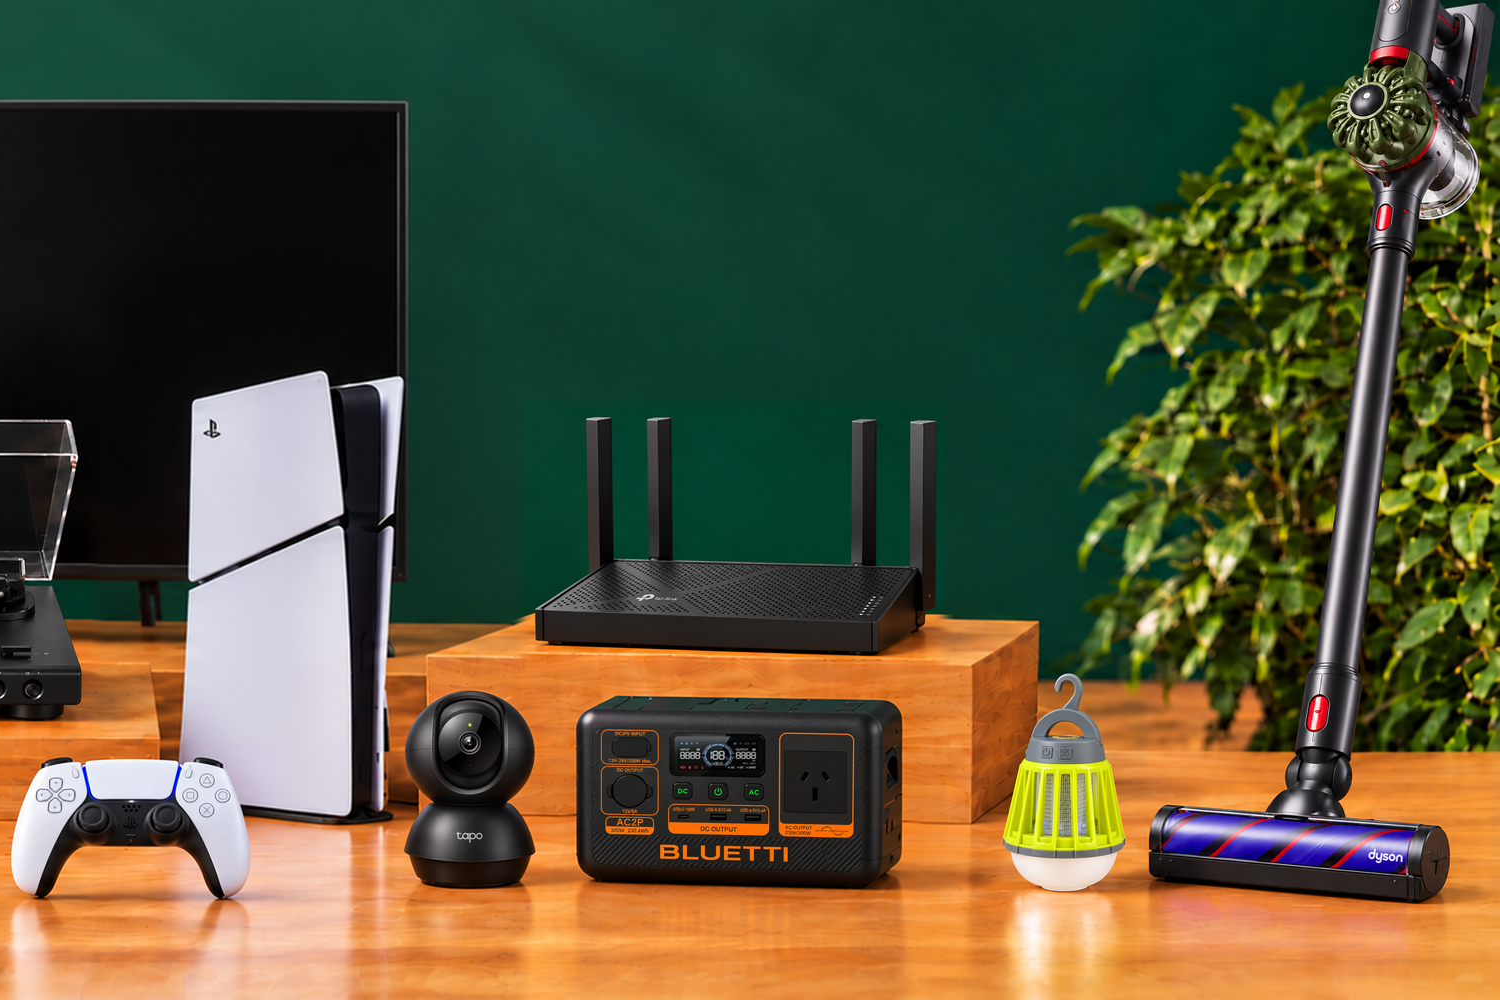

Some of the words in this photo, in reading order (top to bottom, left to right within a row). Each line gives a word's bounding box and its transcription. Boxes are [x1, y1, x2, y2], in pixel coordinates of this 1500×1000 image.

[679, 751, 701, 760] 8888
[735, 751, 757, 760] 8888
[616, 818, 644, 827] AC2P
[710, 825, 737, 833] OUTPUT
[456, 831, 484, 844] tapo
[659, 844, 789, 862] BLUETTI
[1368, 848, 1404, 864] dyson
